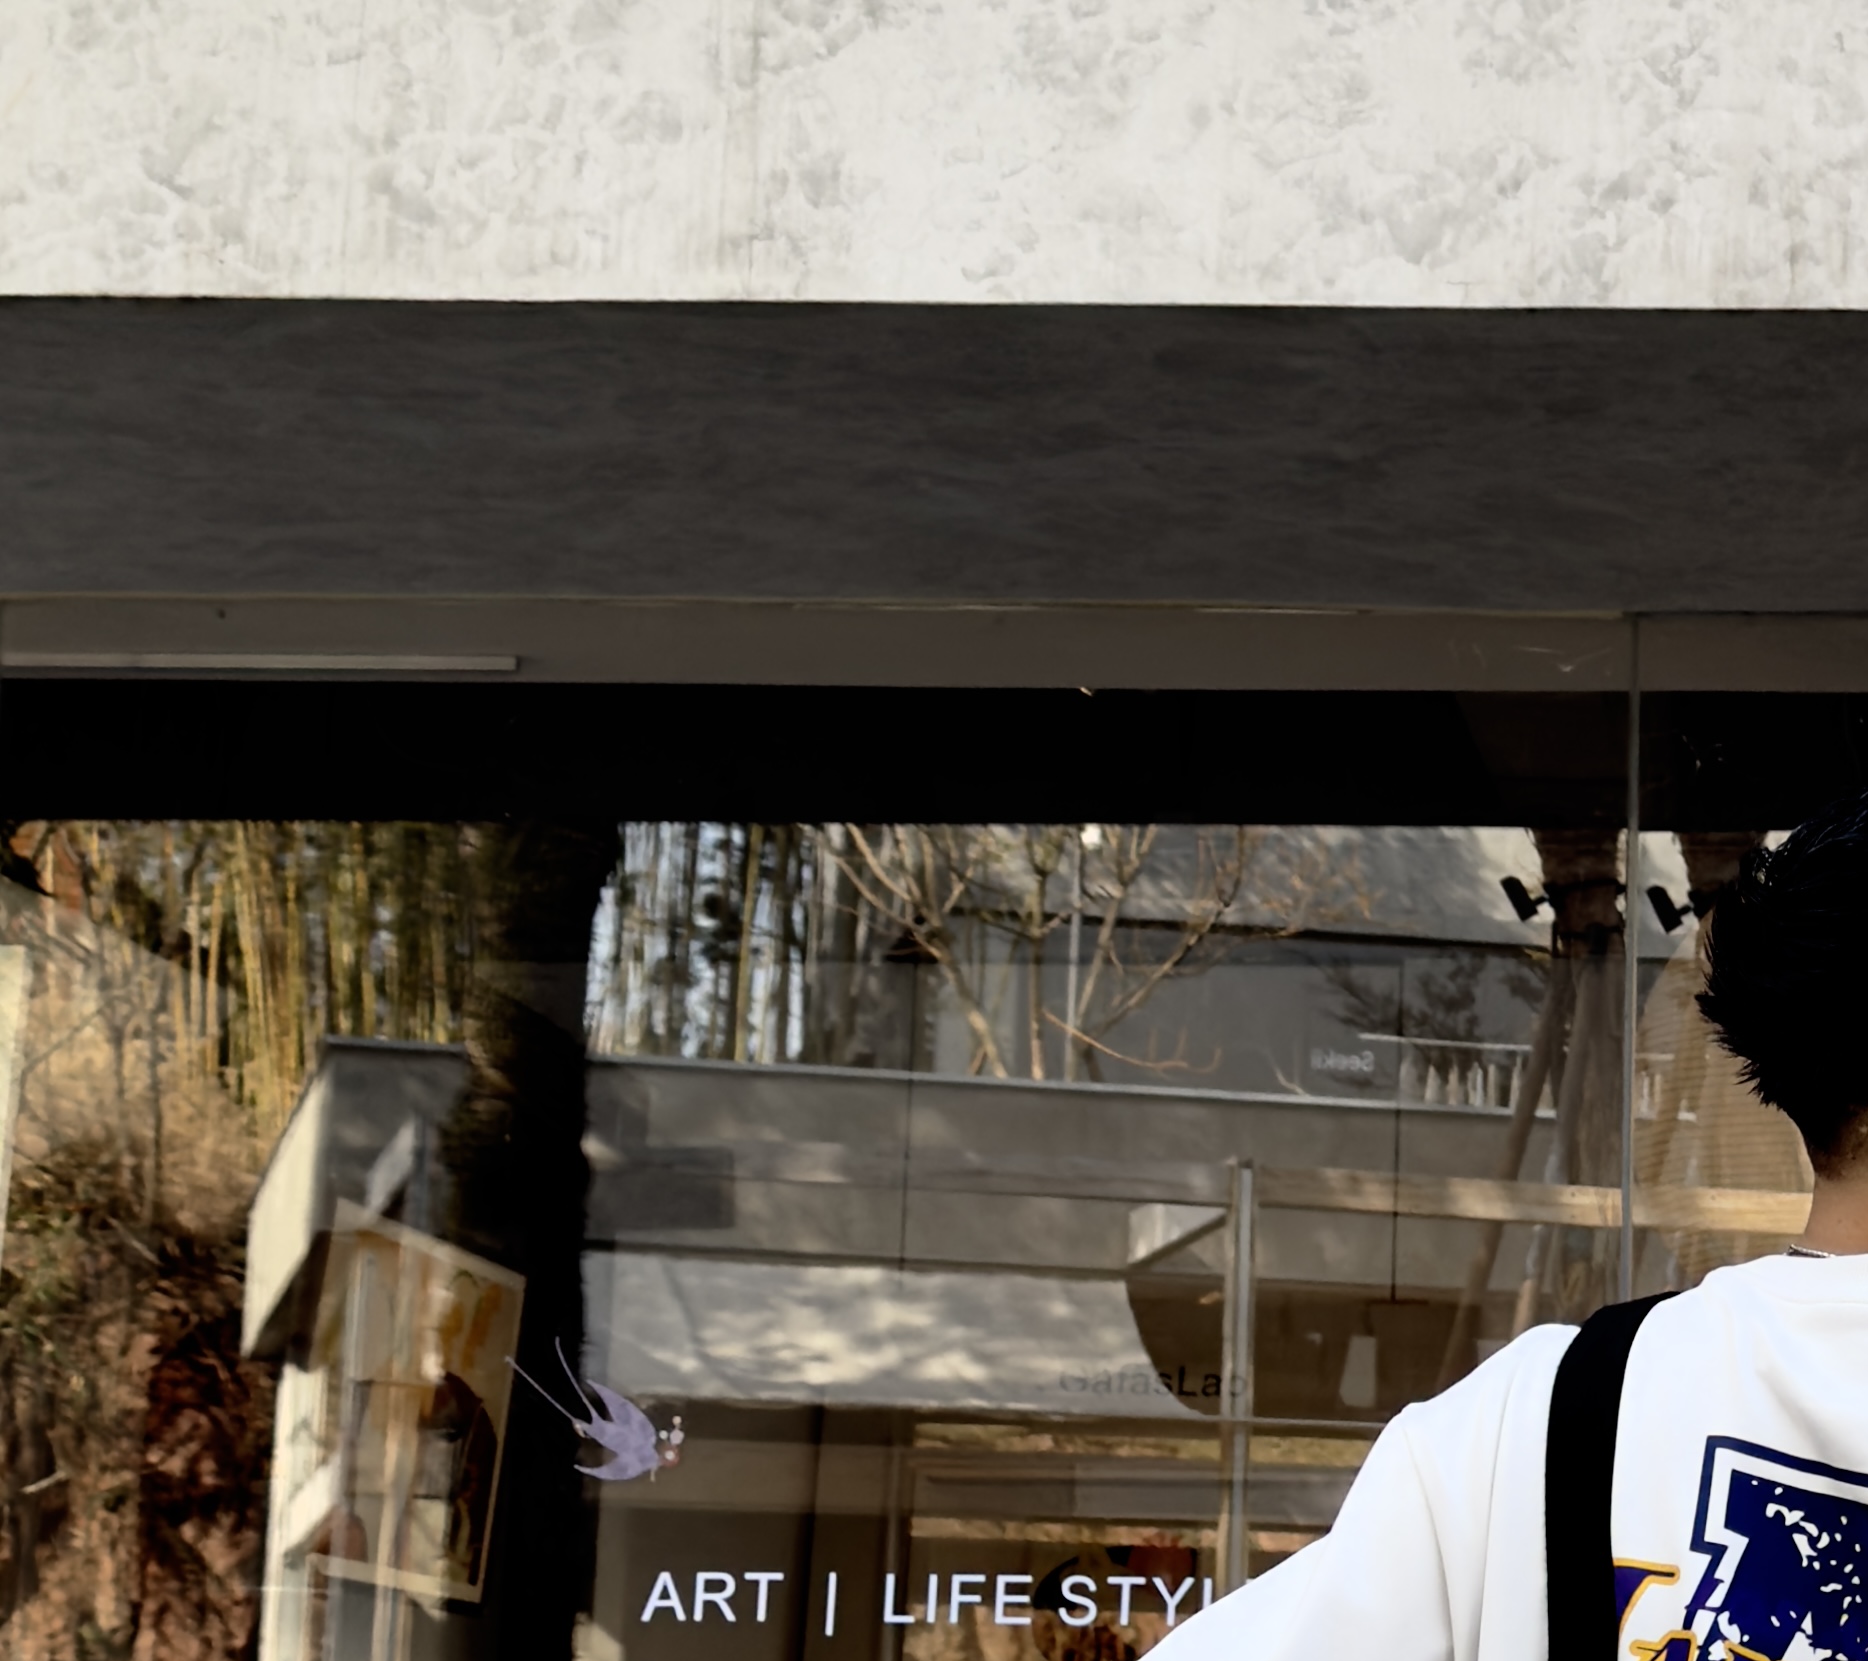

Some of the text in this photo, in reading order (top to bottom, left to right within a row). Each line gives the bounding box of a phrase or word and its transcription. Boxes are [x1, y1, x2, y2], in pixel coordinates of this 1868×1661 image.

[641, 1571, 783, 1624] ART
[883, 1573, 1032, 1625] LIFE
[1058, 1574, 1256, 1628] STY
